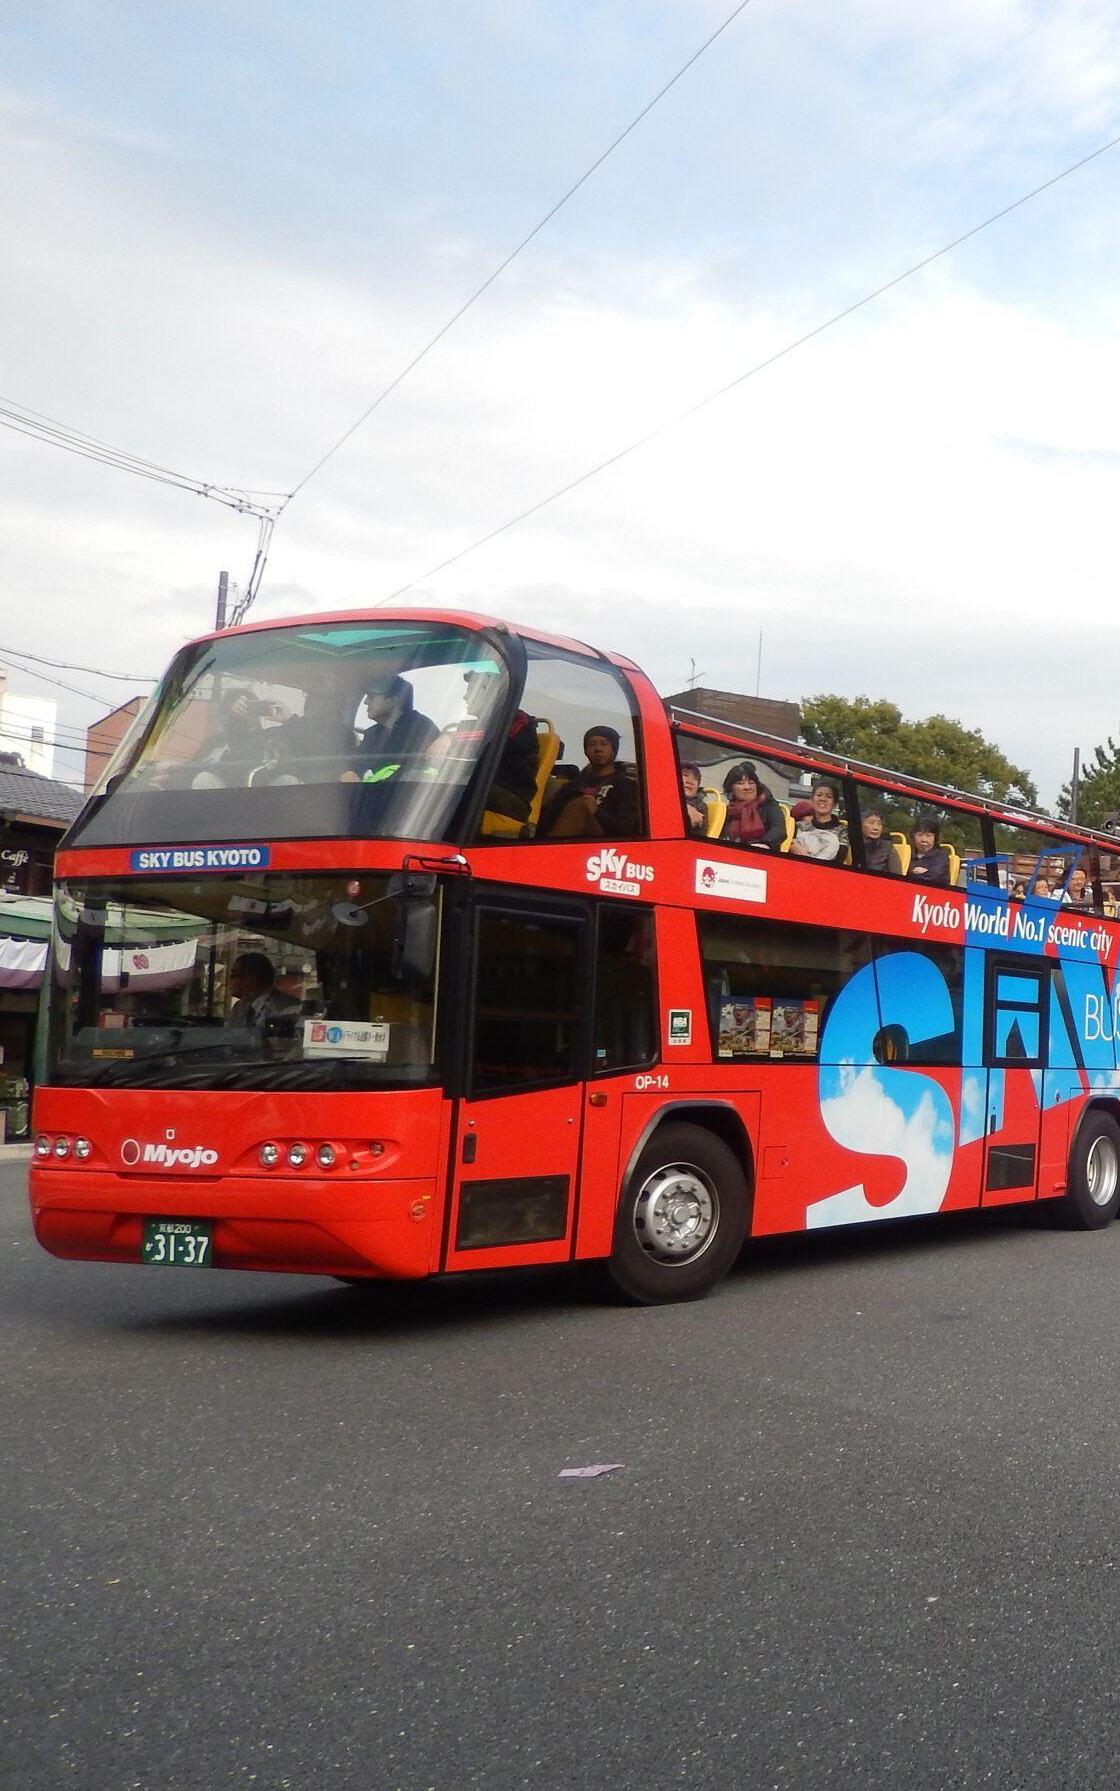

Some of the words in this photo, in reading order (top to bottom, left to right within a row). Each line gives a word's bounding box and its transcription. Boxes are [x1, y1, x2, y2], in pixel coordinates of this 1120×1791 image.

[139, 852, 171, 869] SKY
[173, 851, 204, 867] BUS
[207, 848, 261, 866] KYOTO
[586, 848, 627, 882] SKY
[626, 862, 655, 881] BUS
[911, 894, 960, 934] Kyoto
[963, 902, 1010, 937] World
[1013, 911, 1046, 942] No.1
[1048, 921, 1087, 949] scenic
[1090, 925, 1114, 960] city
[635, 1075, 670, 1090] OP-14
[142, 1144, 219, 1168] Myojo
